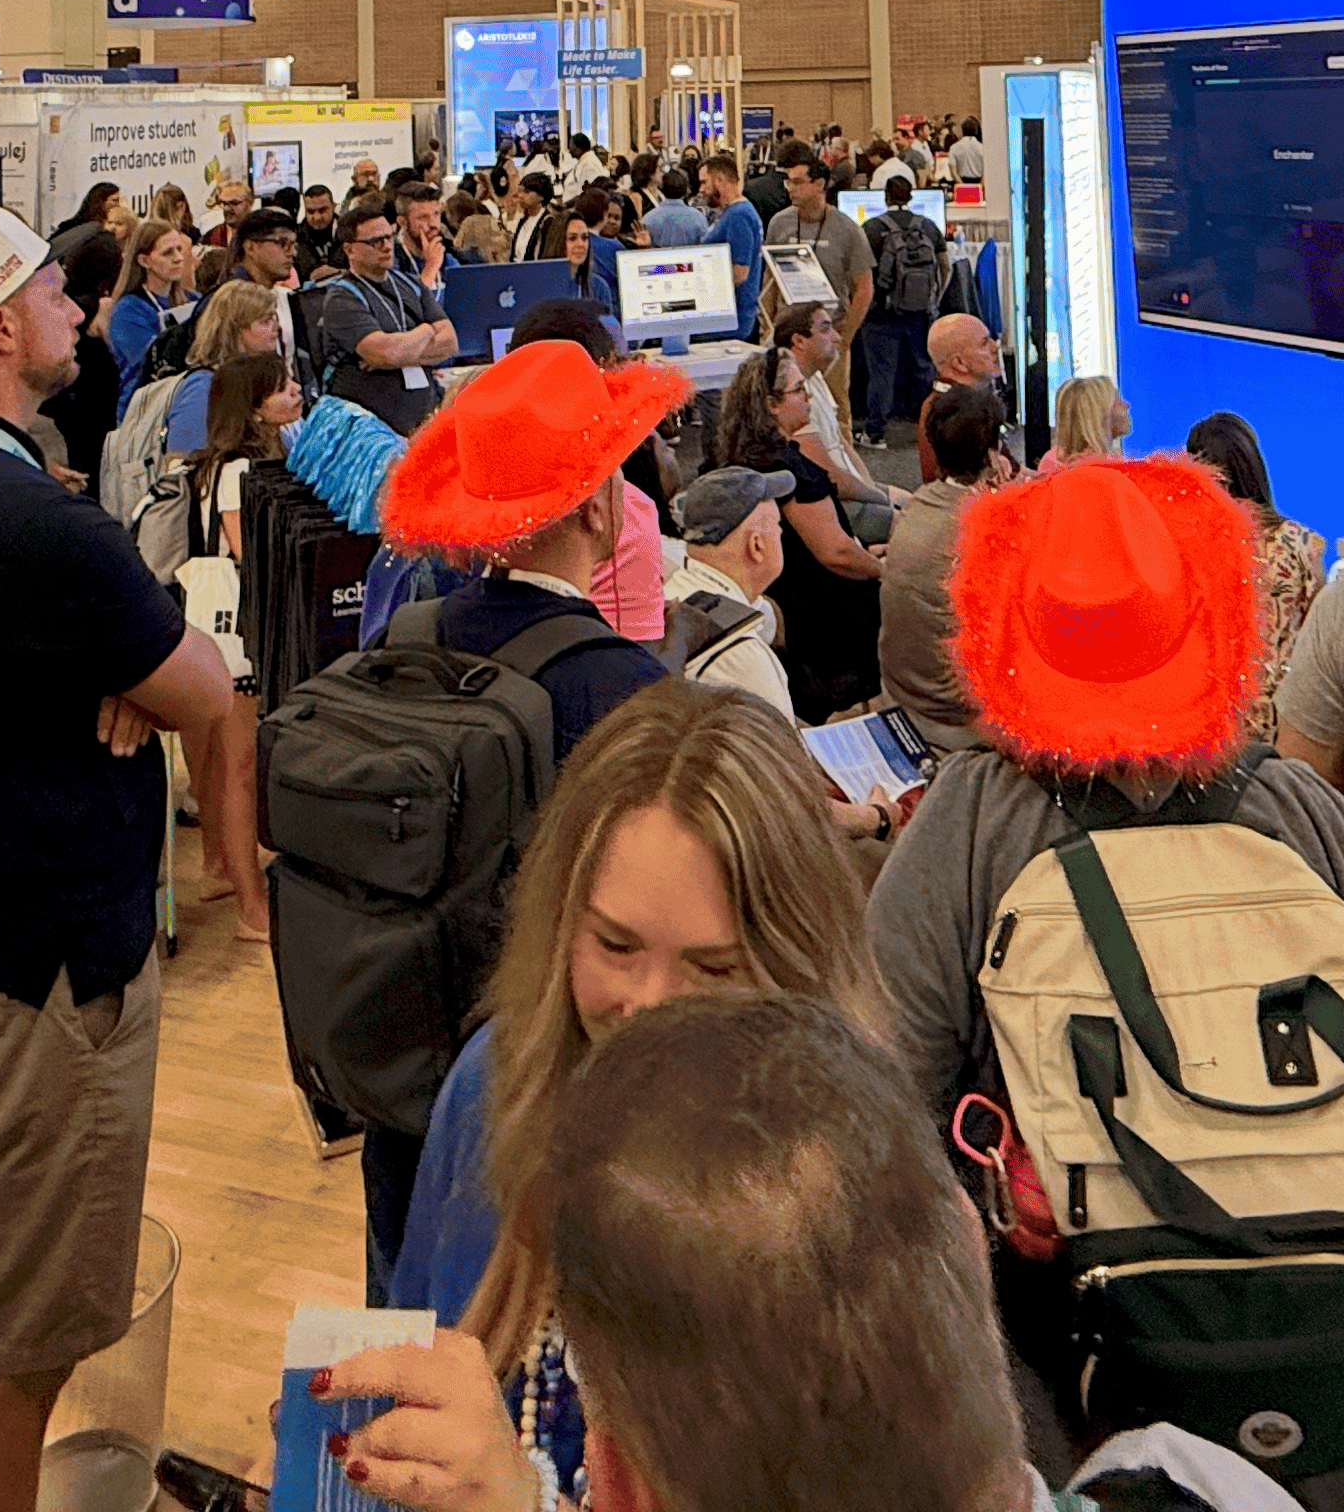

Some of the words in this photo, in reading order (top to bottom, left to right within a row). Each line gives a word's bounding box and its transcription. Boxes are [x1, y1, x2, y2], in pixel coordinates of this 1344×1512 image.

[563, 50, 591, 62] Made
[593, 50, 605, 61] to
[607, 49, 636, 60] Make
[563, 64, 583, 76] Life
[90, 122, 145, 147] Improve
[148, 120, 197, 140] student
[90, 153, 167, 174] attendance
[170, 147, 197, 166] with
